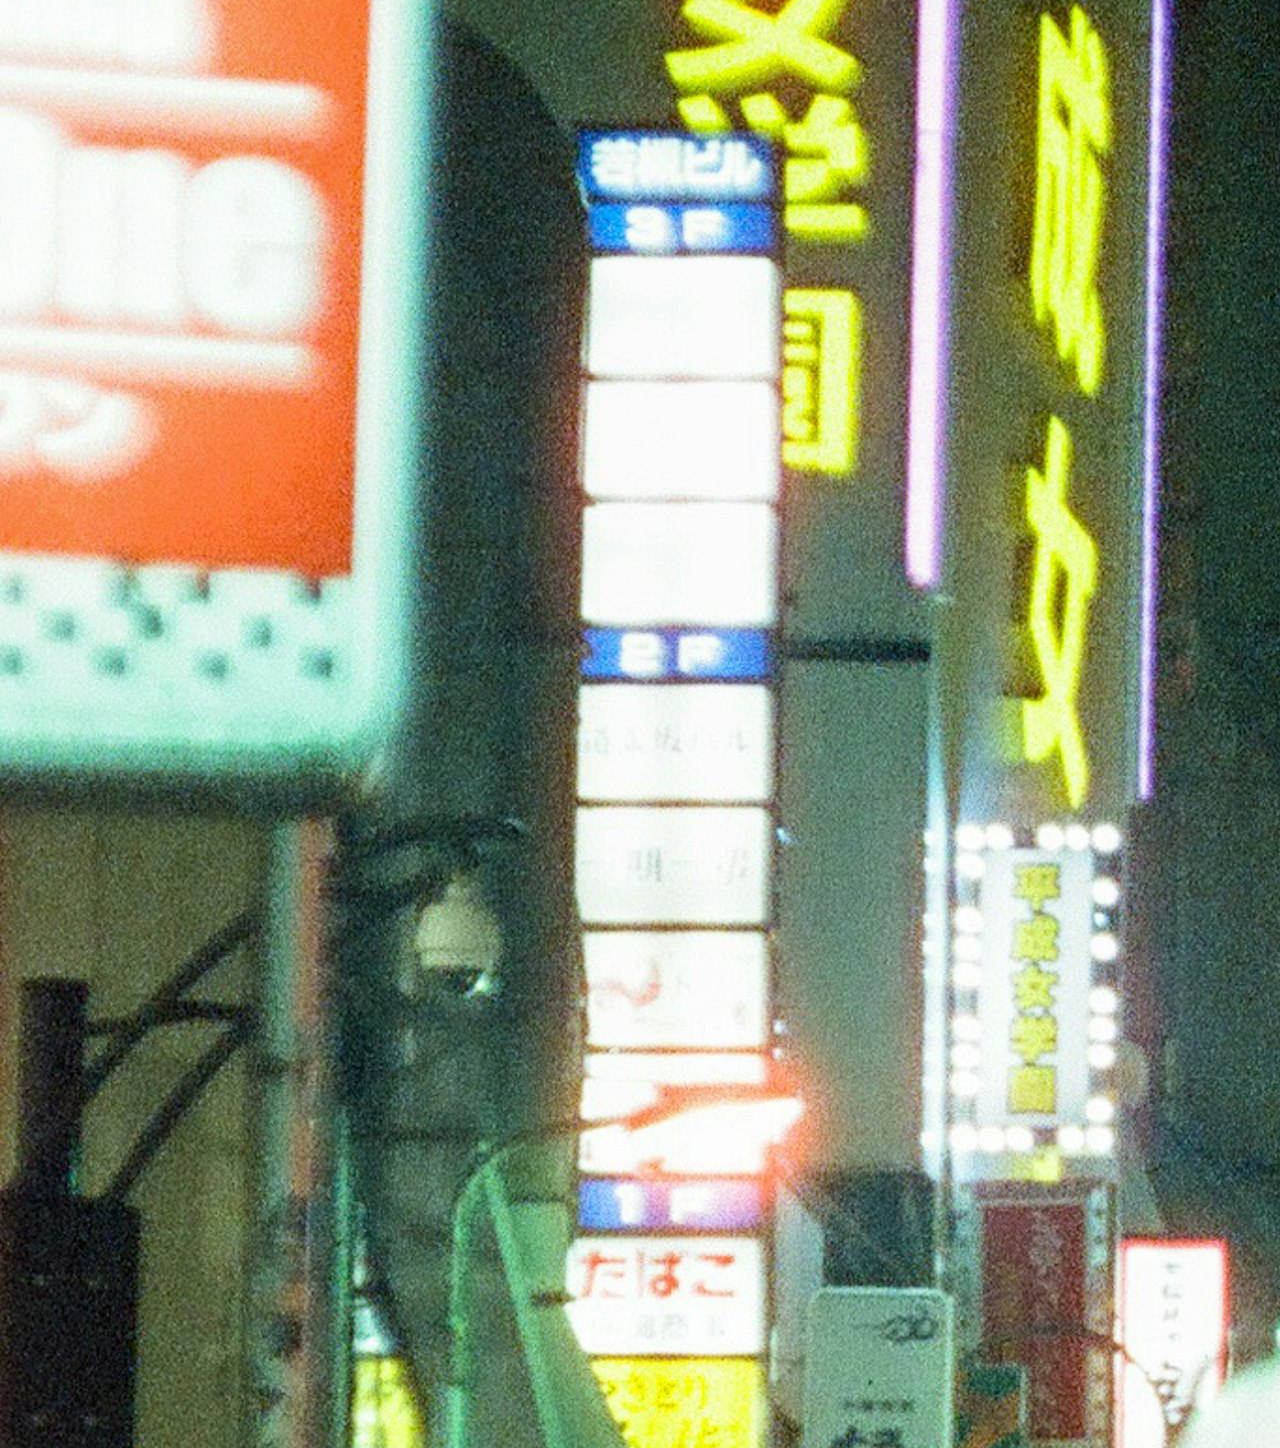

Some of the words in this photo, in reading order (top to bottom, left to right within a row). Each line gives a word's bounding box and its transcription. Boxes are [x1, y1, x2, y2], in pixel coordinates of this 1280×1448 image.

[624, 206, 730, 254] 3F
[618, 634, 726, 676] 2F
[612, 1182, 713, 1226] 1F
[577, 1248, 738, 1299] たばこ
